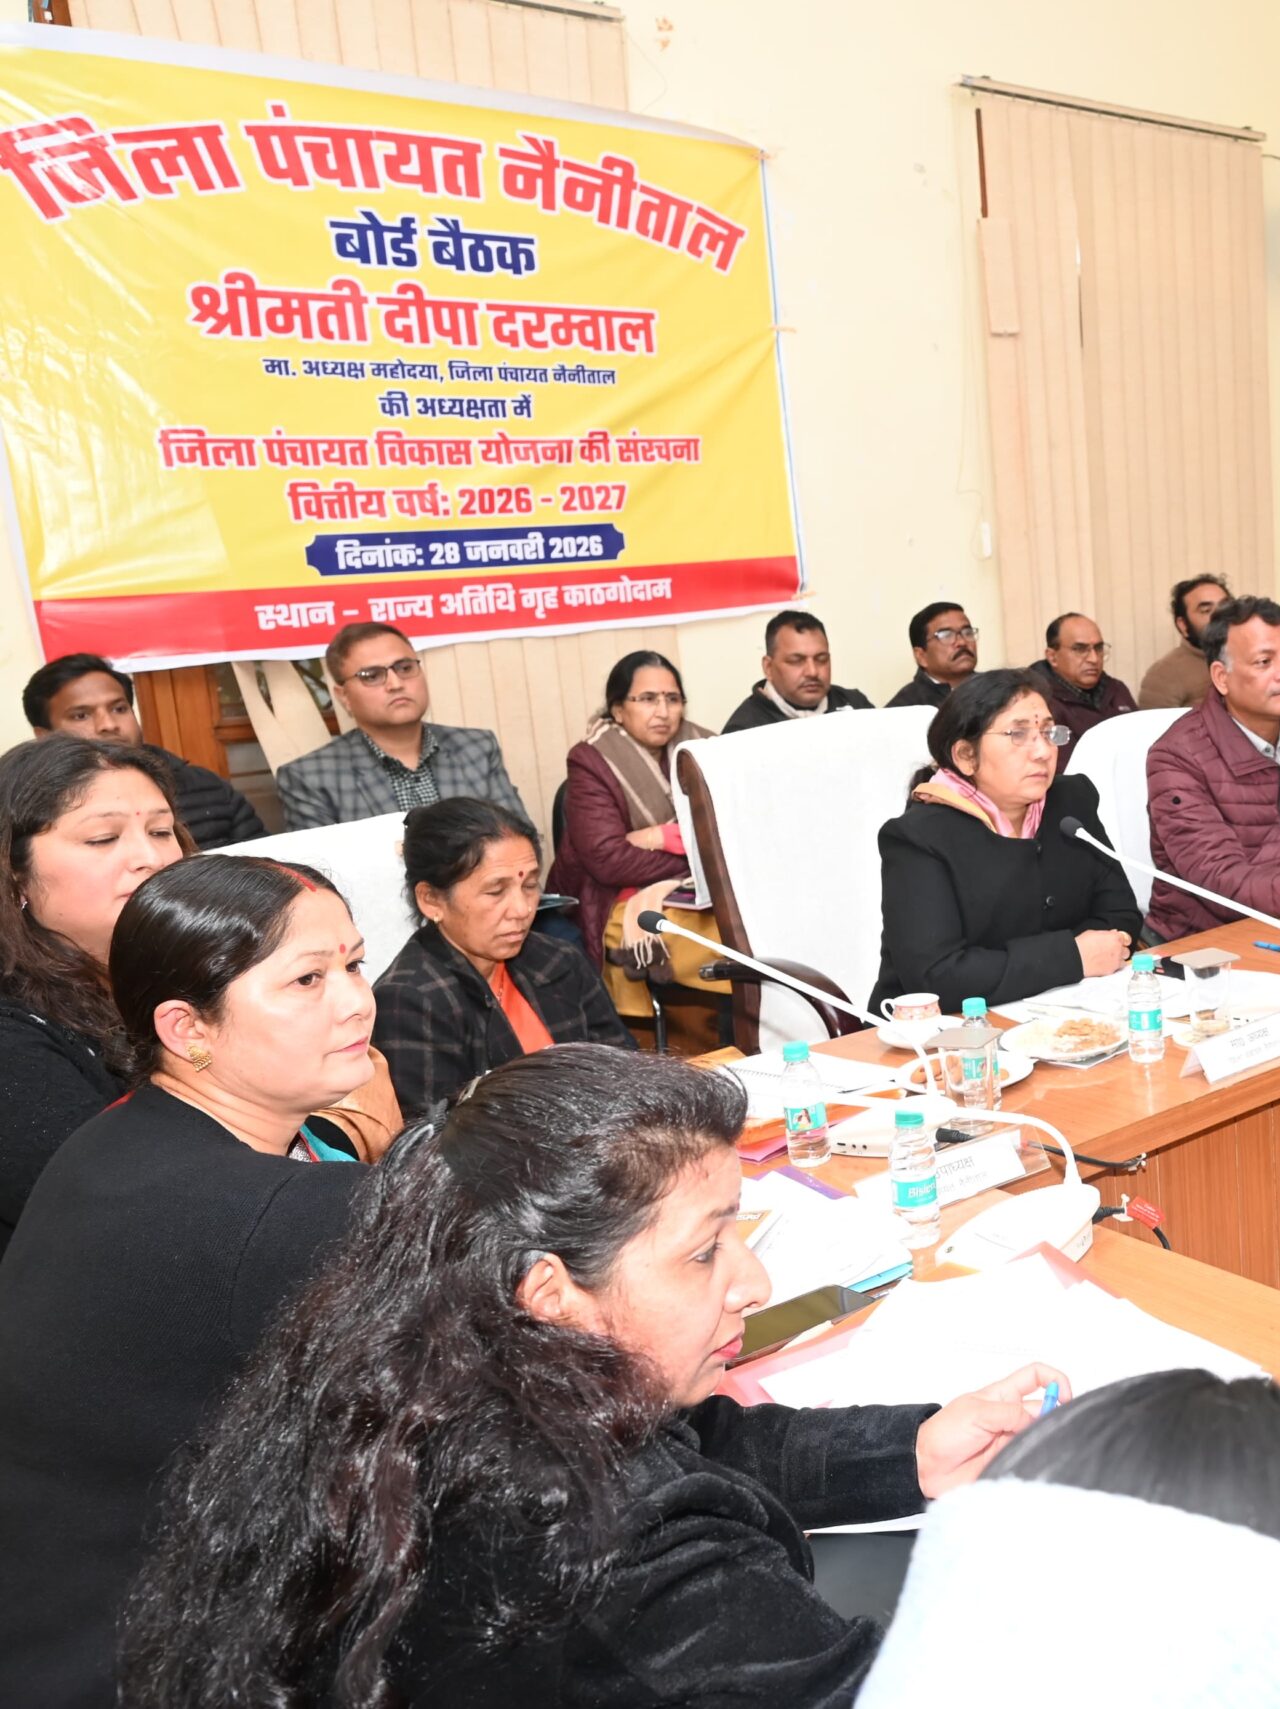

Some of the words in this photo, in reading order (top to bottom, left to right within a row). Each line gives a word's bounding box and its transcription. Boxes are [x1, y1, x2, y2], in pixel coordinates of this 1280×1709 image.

[0, 116, 241, 219] जिला
[244, 104, 482, 199] पंचायत
[498, 134, 746, 272] नैनीताल
[329, 210, 417, 267] बोर्ड
[427, 217, 535, 275] बैठक
[191, 271, 368, 341] श्रीमती
[376, 283, 478, 346] दीपा
[486, 303, 655, 352] दरम्वाल
[262, 358, 297, 376] मा.
[302, 360, 365, 379] अध्यक्ष
[369, 359, 444, 383] महोदया,
[449, 360, 493, 381] जिला
[497, 361, 548, 383] पंचायत
[552, 363, 616, 384] नैनीताल
[379, 391, 409, 416] की
[416, 397, 507, 419] अध्यक्षता
[511, 394, 532, 418] में
[158, 429, 256, 467] जिला
[262, 430, 368, 466] पंचायत
[375, 431, 472, 466] विकास
[478, 432, 573, 464] योजना
[579, 431, 610, 463] की
[615, 430, 700, 463] संरचना
[287, 482, 386, 520] वित्तीय
[392, 483, 450, 516] वर्ष:
[458, 486, 532, 515] 2026
[560, 484, 626, 512] 2027
[335, 538, 424, 569] दिनांक:
[429, 542, 460, 565] 28
[463, 531, 545, 562] जनवरी
[549, 535, 603, 559] 2026
[254, 601, 335, 630] स्थान
[368, 595, 433, 622] राज्य
[440, 582, 516, 616] अतिथि
[520, 586, 559, 619] गृह
[562, 575, 672, 607] काठगोदाम
